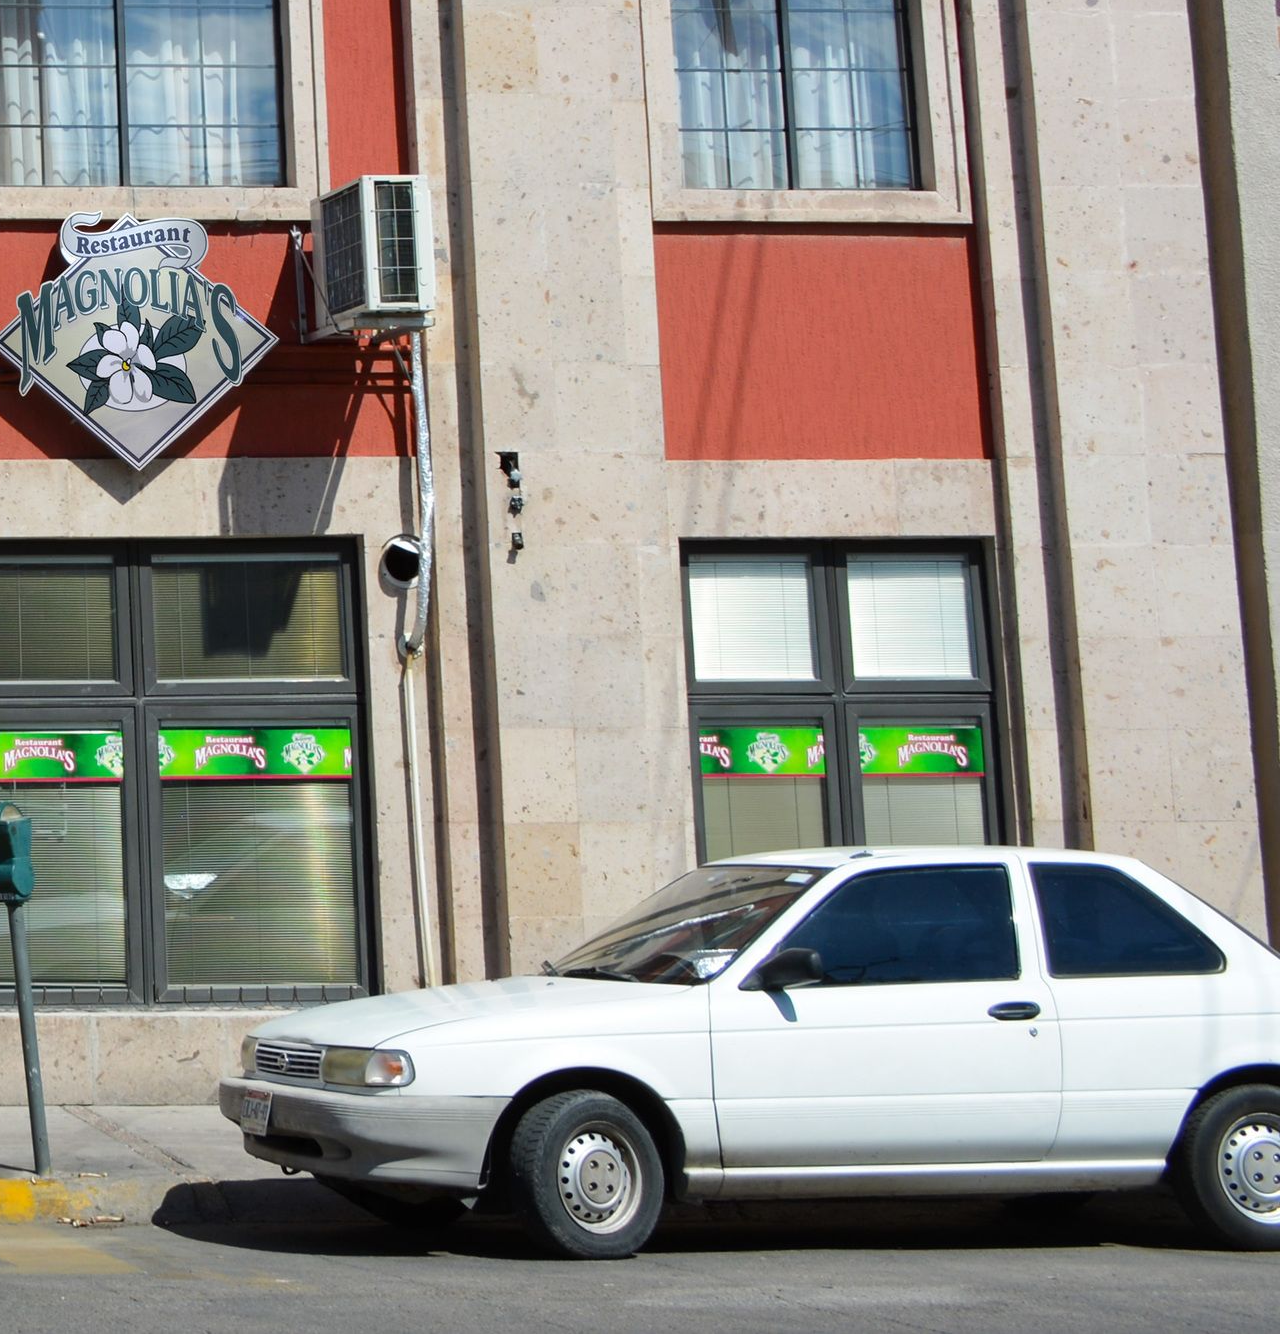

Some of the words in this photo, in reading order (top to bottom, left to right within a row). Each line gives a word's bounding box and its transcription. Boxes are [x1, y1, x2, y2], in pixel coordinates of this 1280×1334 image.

[76, 225, 191, 255] Restaurant
[17, 267, 243, 397] MAGNOLIA'S
[15, 738, 63, 747] Restaurant
[205, 736, 254, 744] Restaurant
[908, 734, 955, 742] Restaurant
[4, 746, 75, 772] MAGNOLIA'S
[194, 744, 266, 770] MAGNOLIA'S
[898, 742, 968, 768] MAGNOLIA'S
